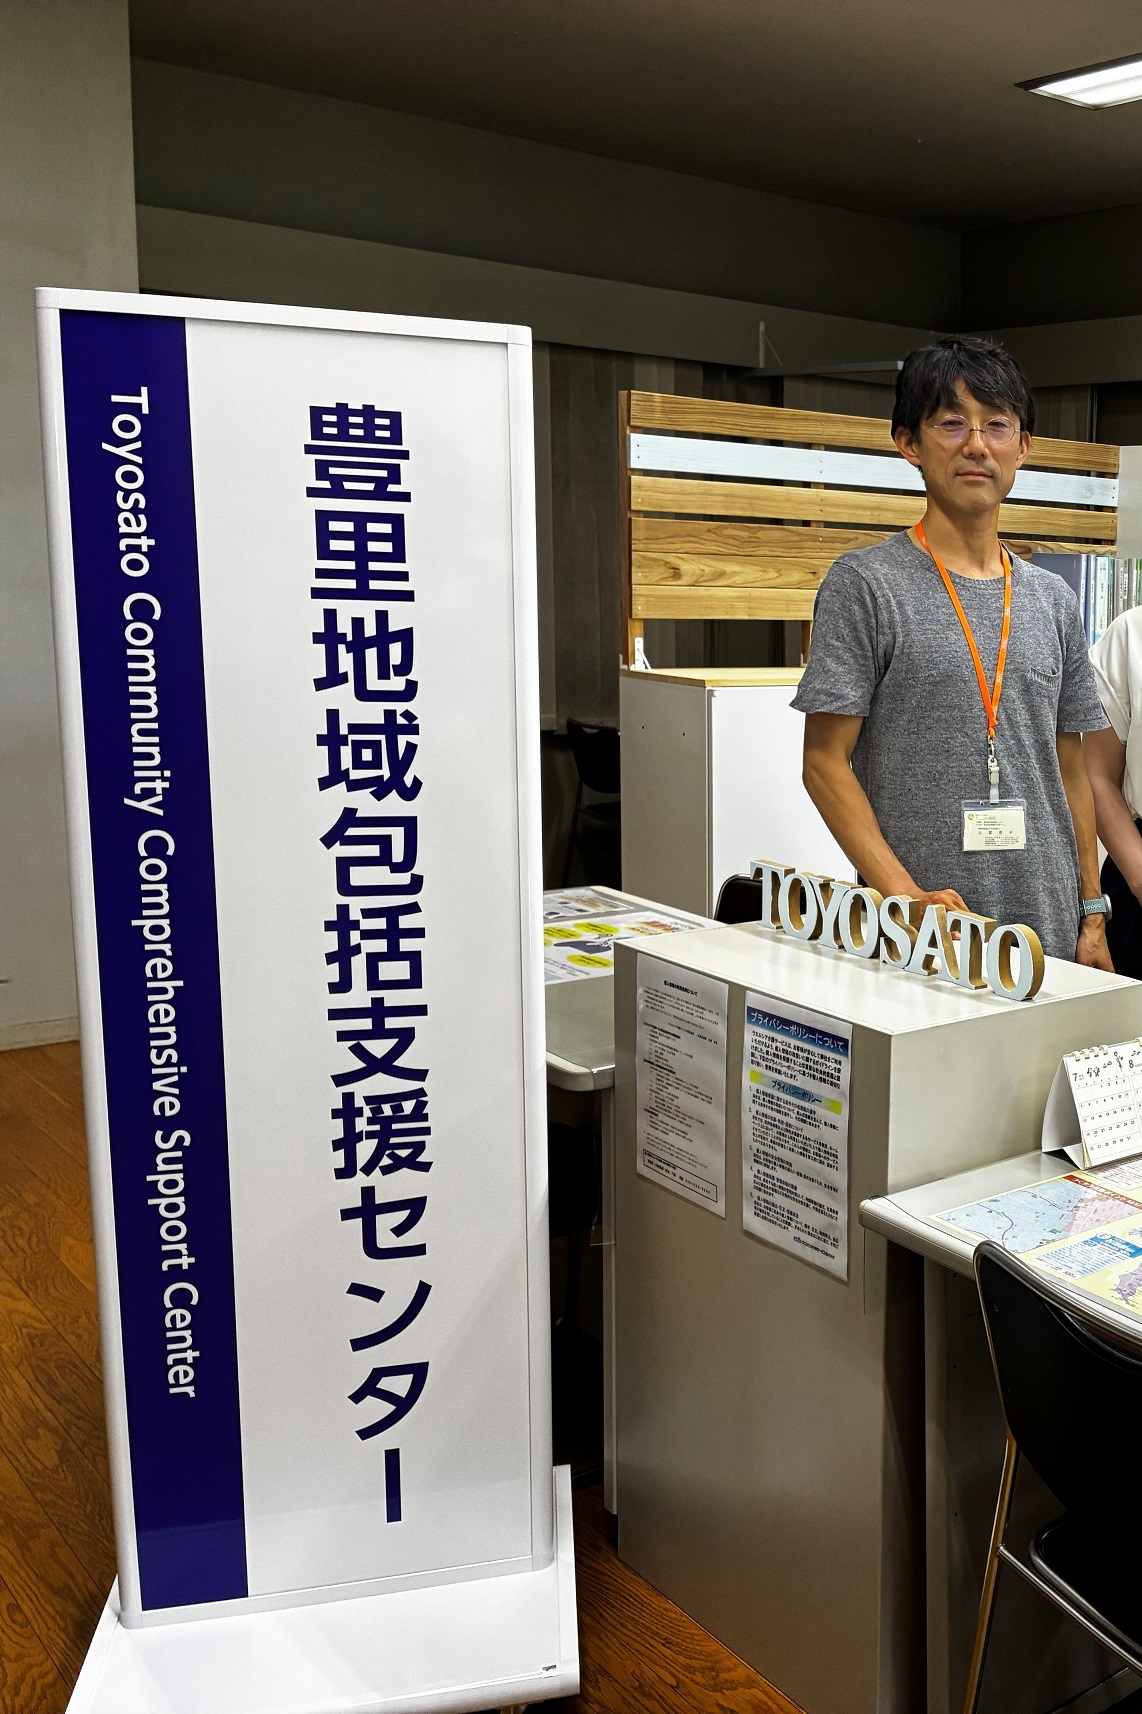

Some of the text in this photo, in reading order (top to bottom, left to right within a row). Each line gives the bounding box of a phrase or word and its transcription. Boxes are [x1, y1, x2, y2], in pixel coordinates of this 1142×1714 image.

[101, 386, 201, 1399] Toyosato Community Comprehensive Support Center
[750, 859, 1045, 1001] TOYOSATO
[303, 402, 434, 1523] 豊里地域包括支援センター
[750, 1010, 845, 1052] プライバシーポリシーについて
[1072, 1072, 1078, 1082] 7
[1128, 1059, 1135, 1068] 8
[771, 1079, 823, 1105] プライバシーポリシー
